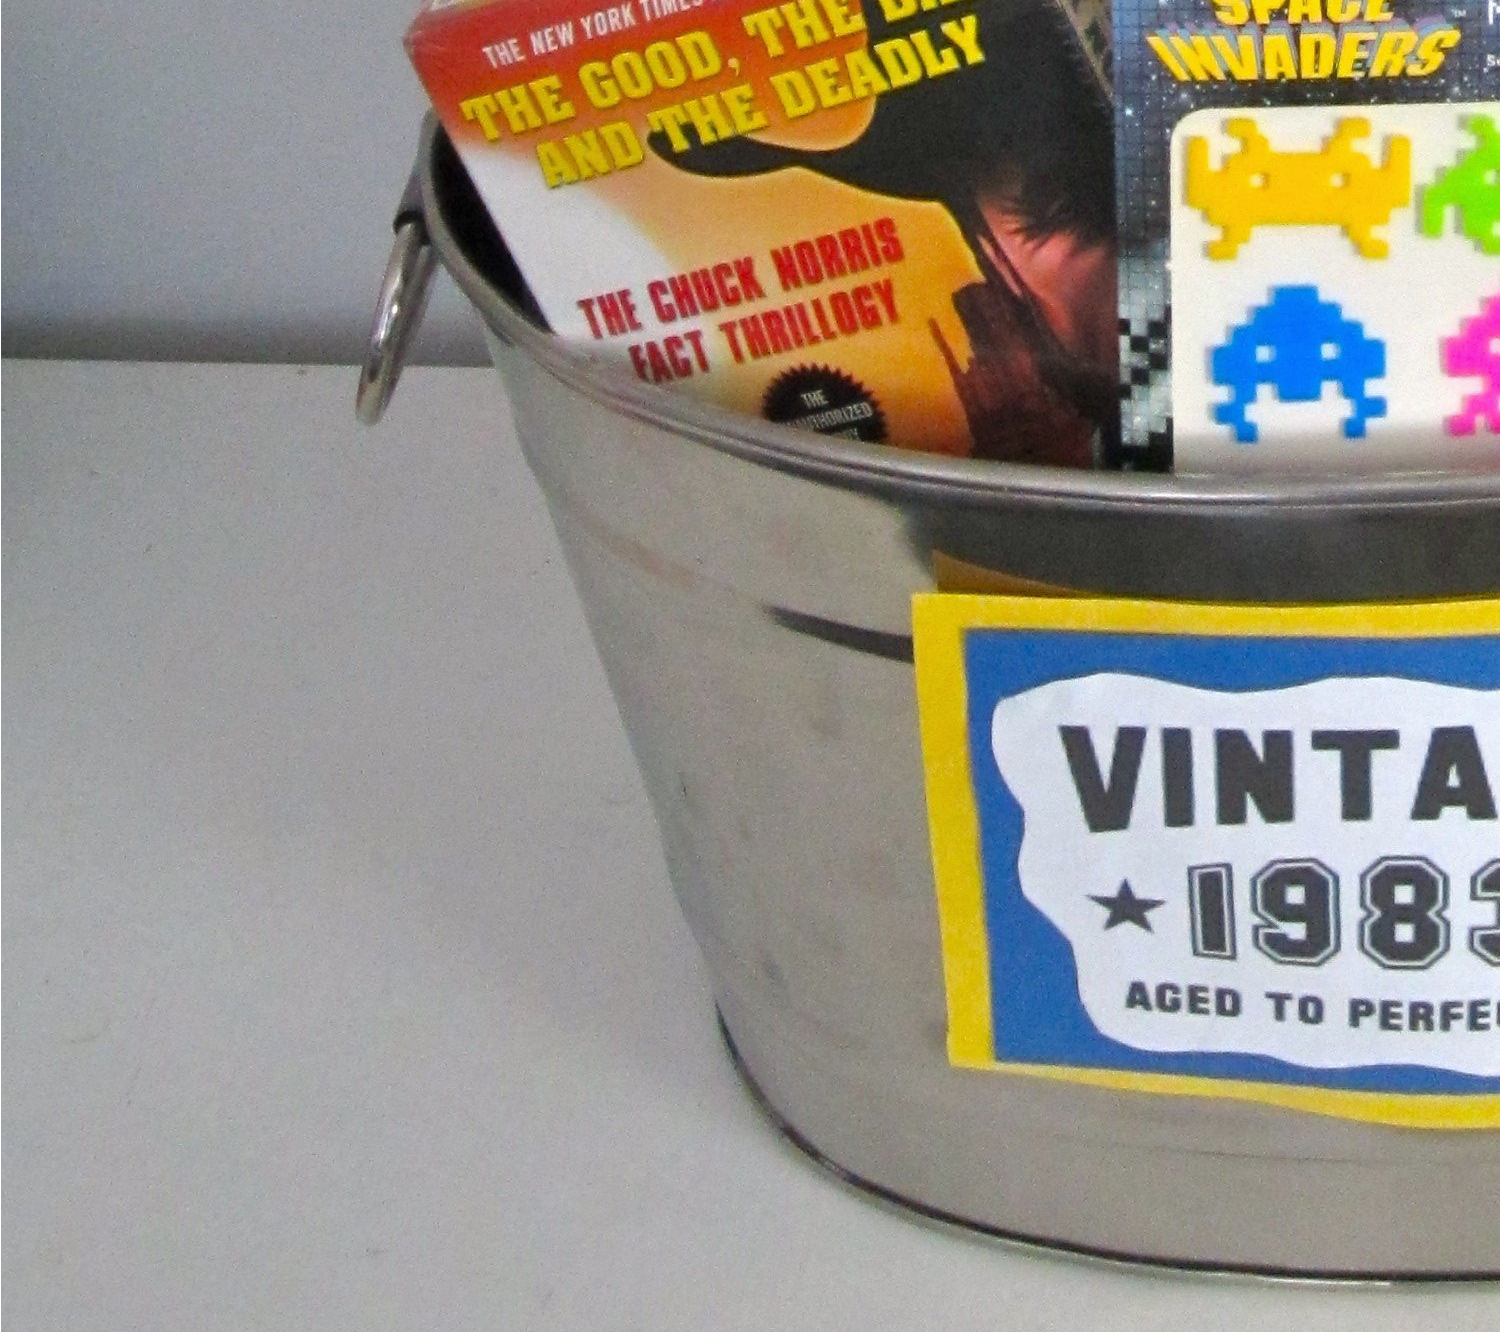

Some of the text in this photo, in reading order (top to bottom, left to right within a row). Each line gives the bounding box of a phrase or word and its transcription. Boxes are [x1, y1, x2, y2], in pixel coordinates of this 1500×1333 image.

[482, 37, 526, 70] THE
[527, 20, 574, 56] NEW
[579, 3, 634, 46] YORK
[1146, 14, 1463, 83] INVADERS
[460, 72, 577, 143] THE
[578, 29, 743, 112] GOOD,
[536, 15, 988, 191] AND THE DEADLY
[578, 216, 905, 341] THE CHUCK NORRIS
[628, 279, 901, 386] FACT THRILLOGY
[801, 389, 829, 410] THE
[1126, 981, 1240, 1019] AGED
[1265, 991, 1324, 1026] TO
